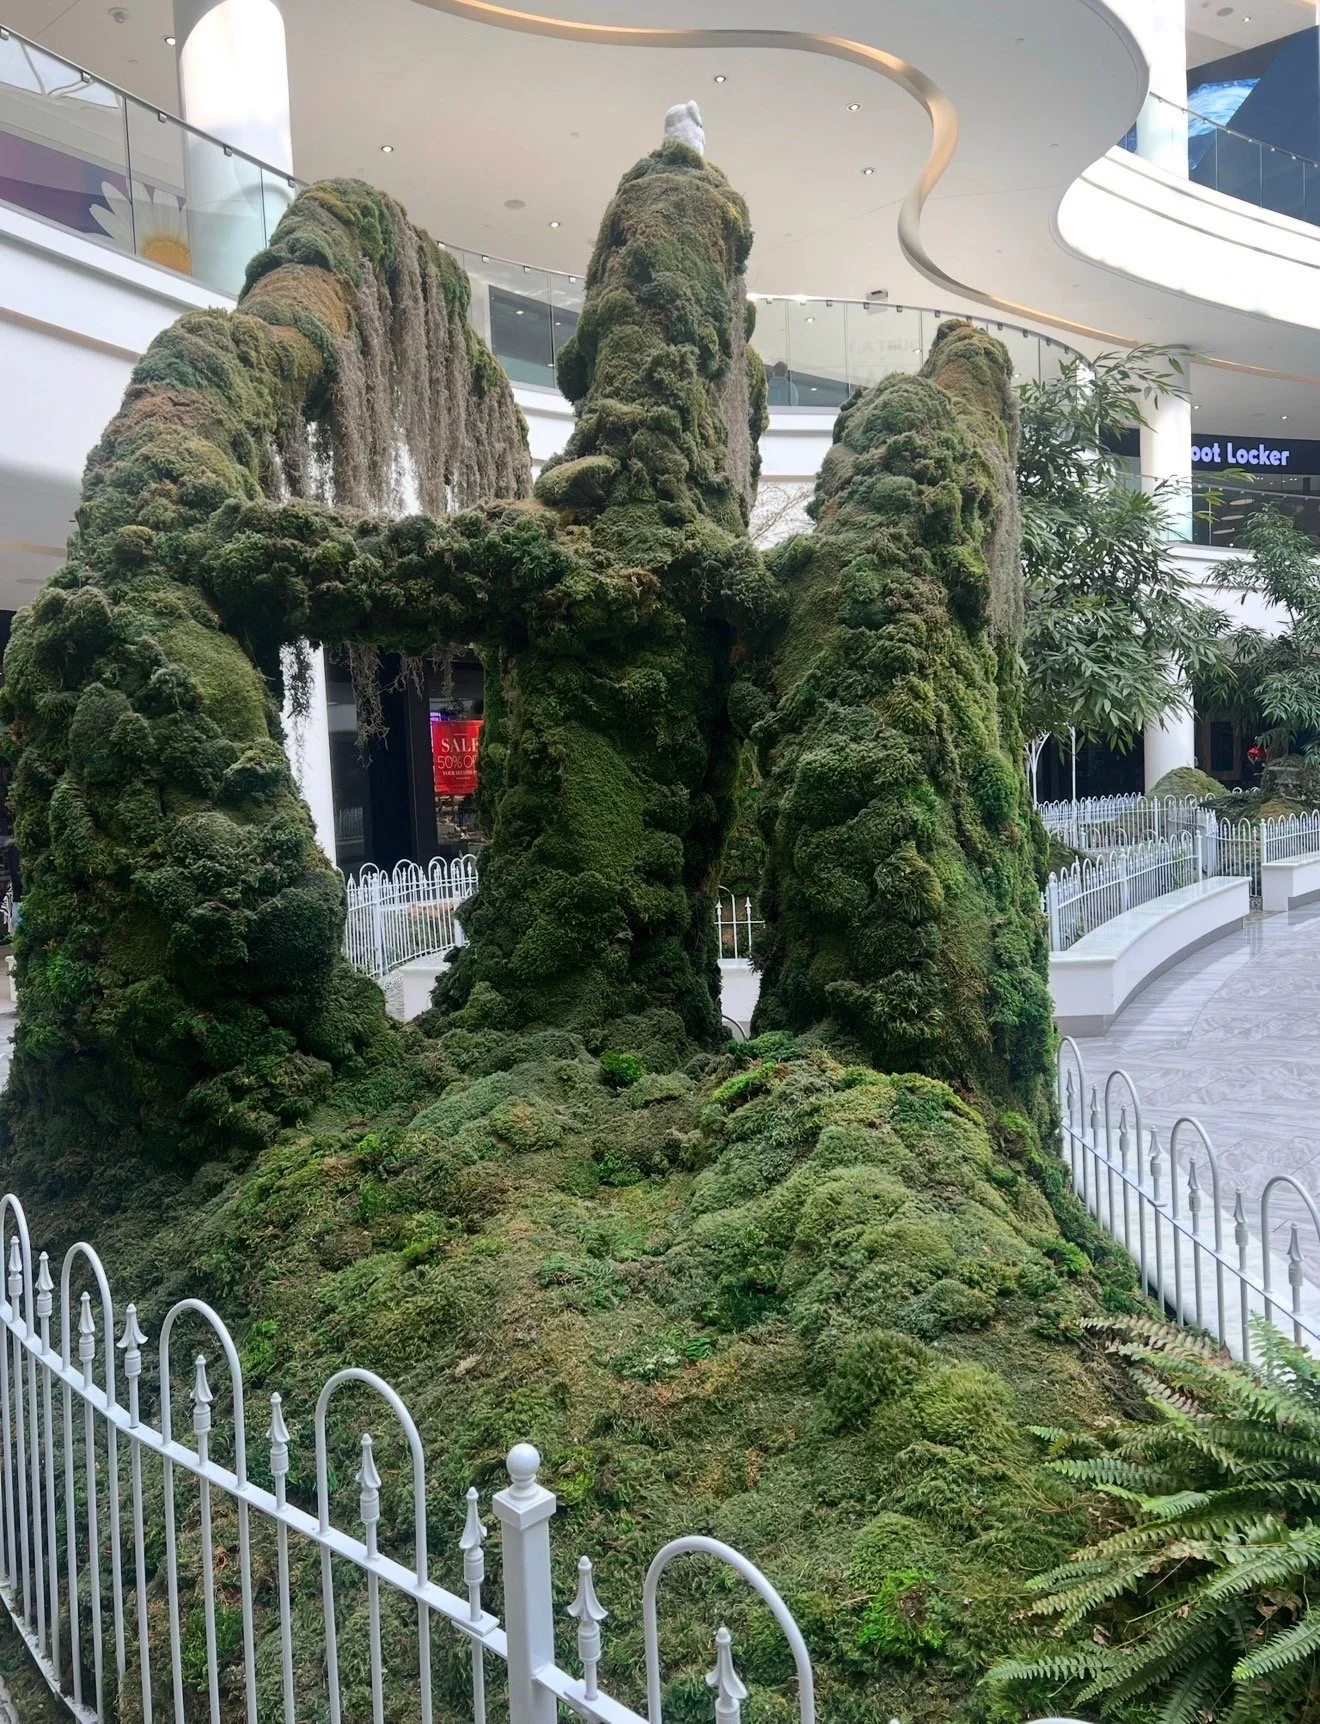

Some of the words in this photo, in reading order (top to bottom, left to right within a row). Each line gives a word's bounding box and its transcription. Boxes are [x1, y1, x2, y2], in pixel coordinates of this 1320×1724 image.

[1191, 442, 1221, 463] oot
[1227, 442, 1290, 466] Locker
[438, 755, 462, 769] 50%
